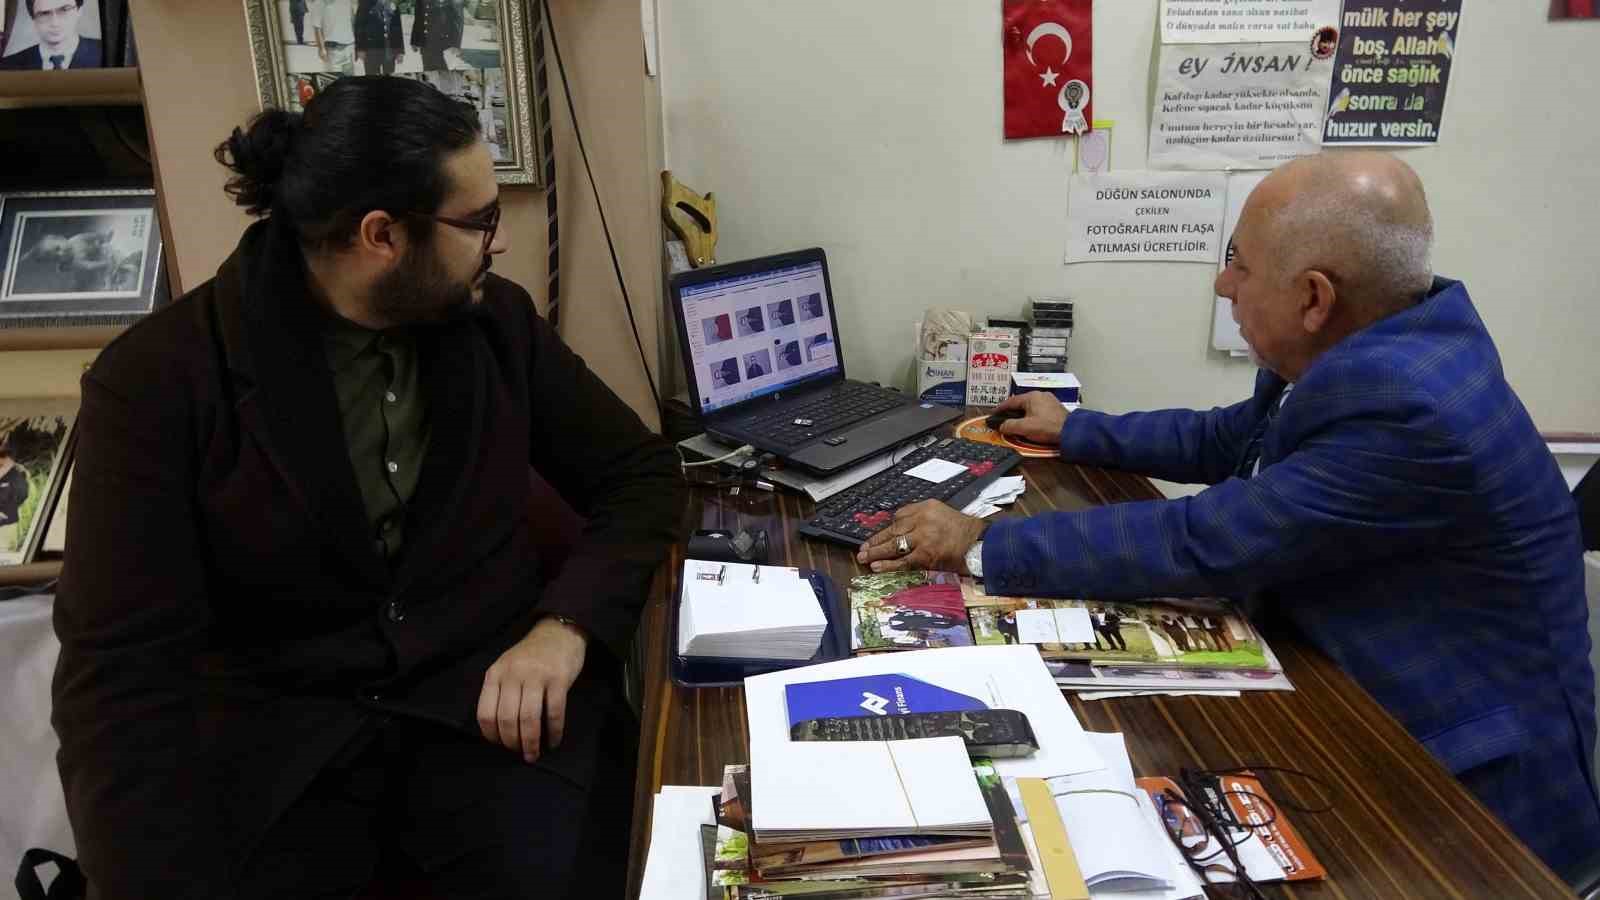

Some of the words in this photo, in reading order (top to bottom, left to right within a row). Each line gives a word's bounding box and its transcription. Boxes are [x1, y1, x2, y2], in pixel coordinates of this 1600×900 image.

[1344, 7, 1389, 27] mülk
[1392, 8, 1423, 27] her
[1425, 10, 1459, 32] şey
[1352, 36, 1389, 59] boş.
[1391, 36, 1438, 55] Allah
[1341, 63, 1384, 83] önce
[1387, 63, 1441, 87] sağlık
[1349, 94, 1398, 111] sonra
[1327, 119, 1378, 138] huzur
[1381, 119, 1437, 138] versin.
[1096, 187, 1138, 200] DÜĞÜN
[1140, 188, 1212, 199] SALONUNDA
[1135, 206, 1170, 217] ÇEKİLEN
[1087, 222, 1179, 235] FOTOĞRAFLARIN
[1181, 223, 1215, 235] FLAŞA
[1088, 242, 1140, 254] ATILMASI
[1143, 240, 1209, 252] ÜCRETLİDİR.
